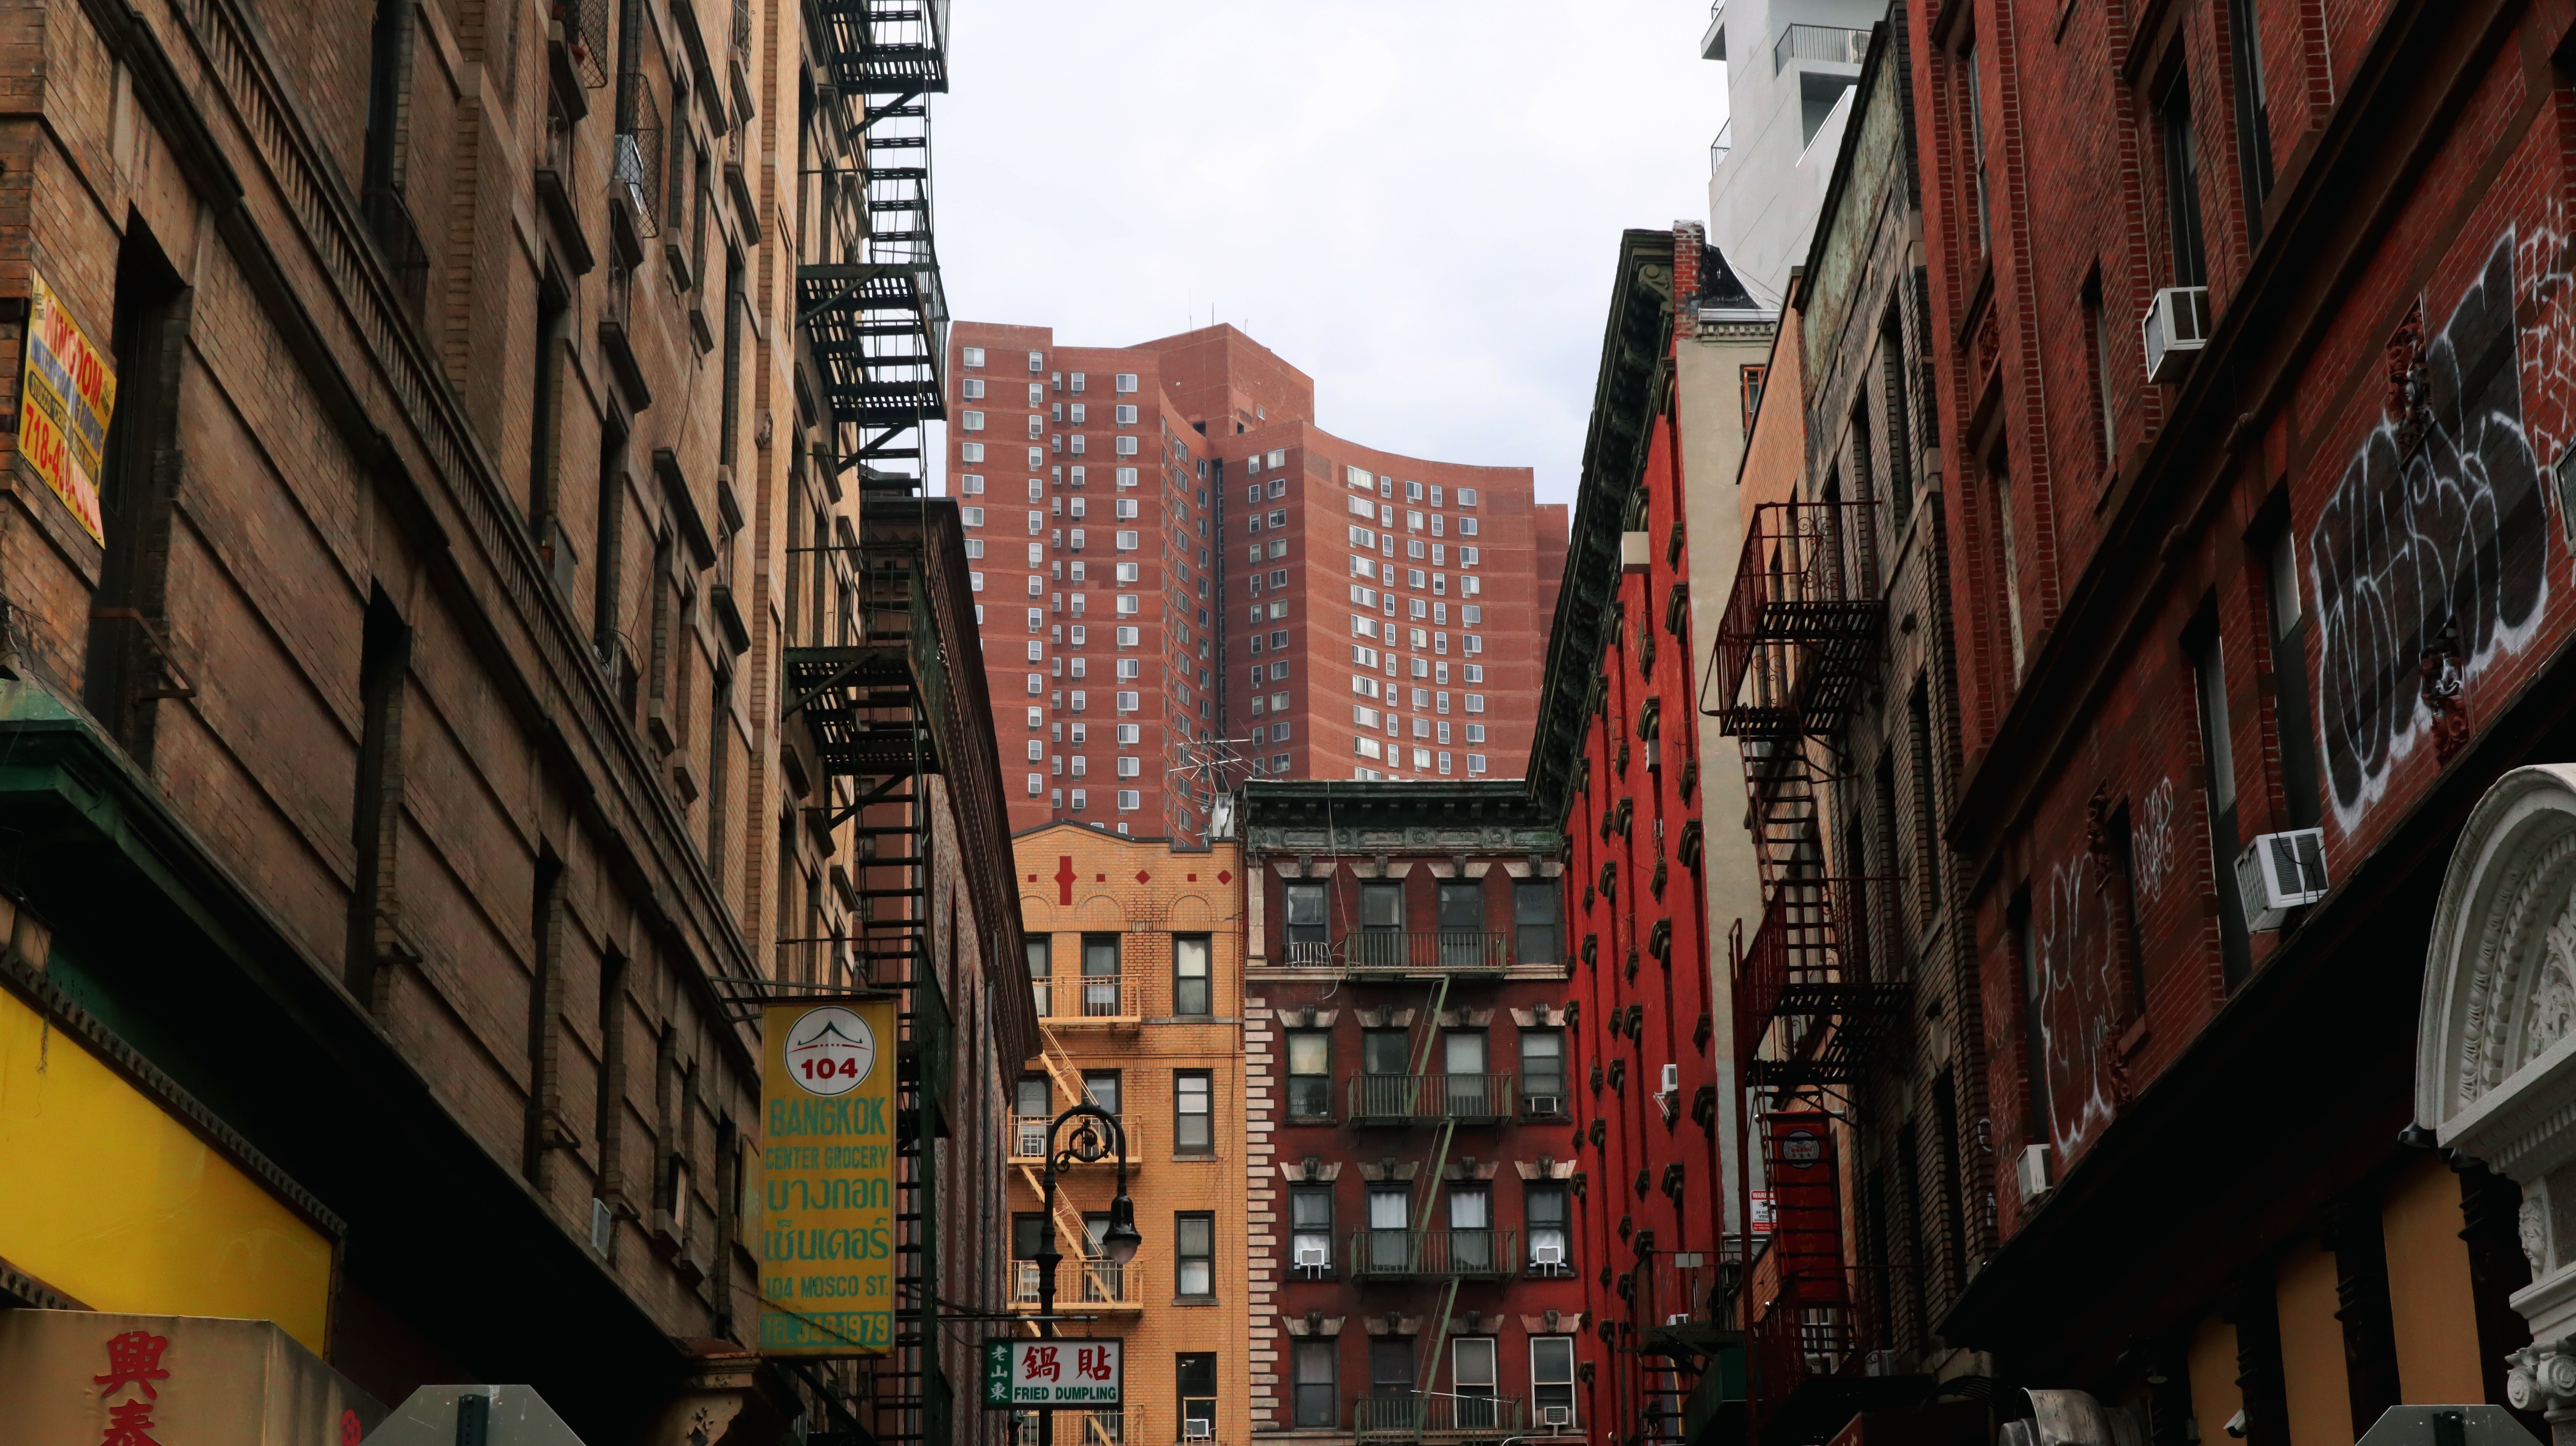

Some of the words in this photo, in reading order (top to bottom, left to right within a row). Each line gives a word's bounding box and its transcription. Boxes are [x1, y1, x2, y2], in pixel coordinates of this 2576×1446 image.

[44, 298, 103, 410] KINGDOM
[30, 329, 81, 423] WATERPROOG
[30, 374, 52, 415] STUCCO
[801, 1058, 858, 1079] 104
[770, 1097, 887, 1136] BANGKOK
[765, 1146, 819, 1170] CENTER
[824, 1145, 890, 1169] GROCERY
[767, 1178, 890, 1211] บางกอก
[765, 1277, 793, 1299] 104
[801, 1276, 859, 1298] MOSCO
[866, 1274, 888, 1296] ST.
[990, 1345, 1008, 1400] 老山東
[1021, 1345, 1112, 1383] 鍋貼
[1015, 1387, 1049, 1400] FRIED
[1056, 1387, 1116, 1400] DUMPLING
